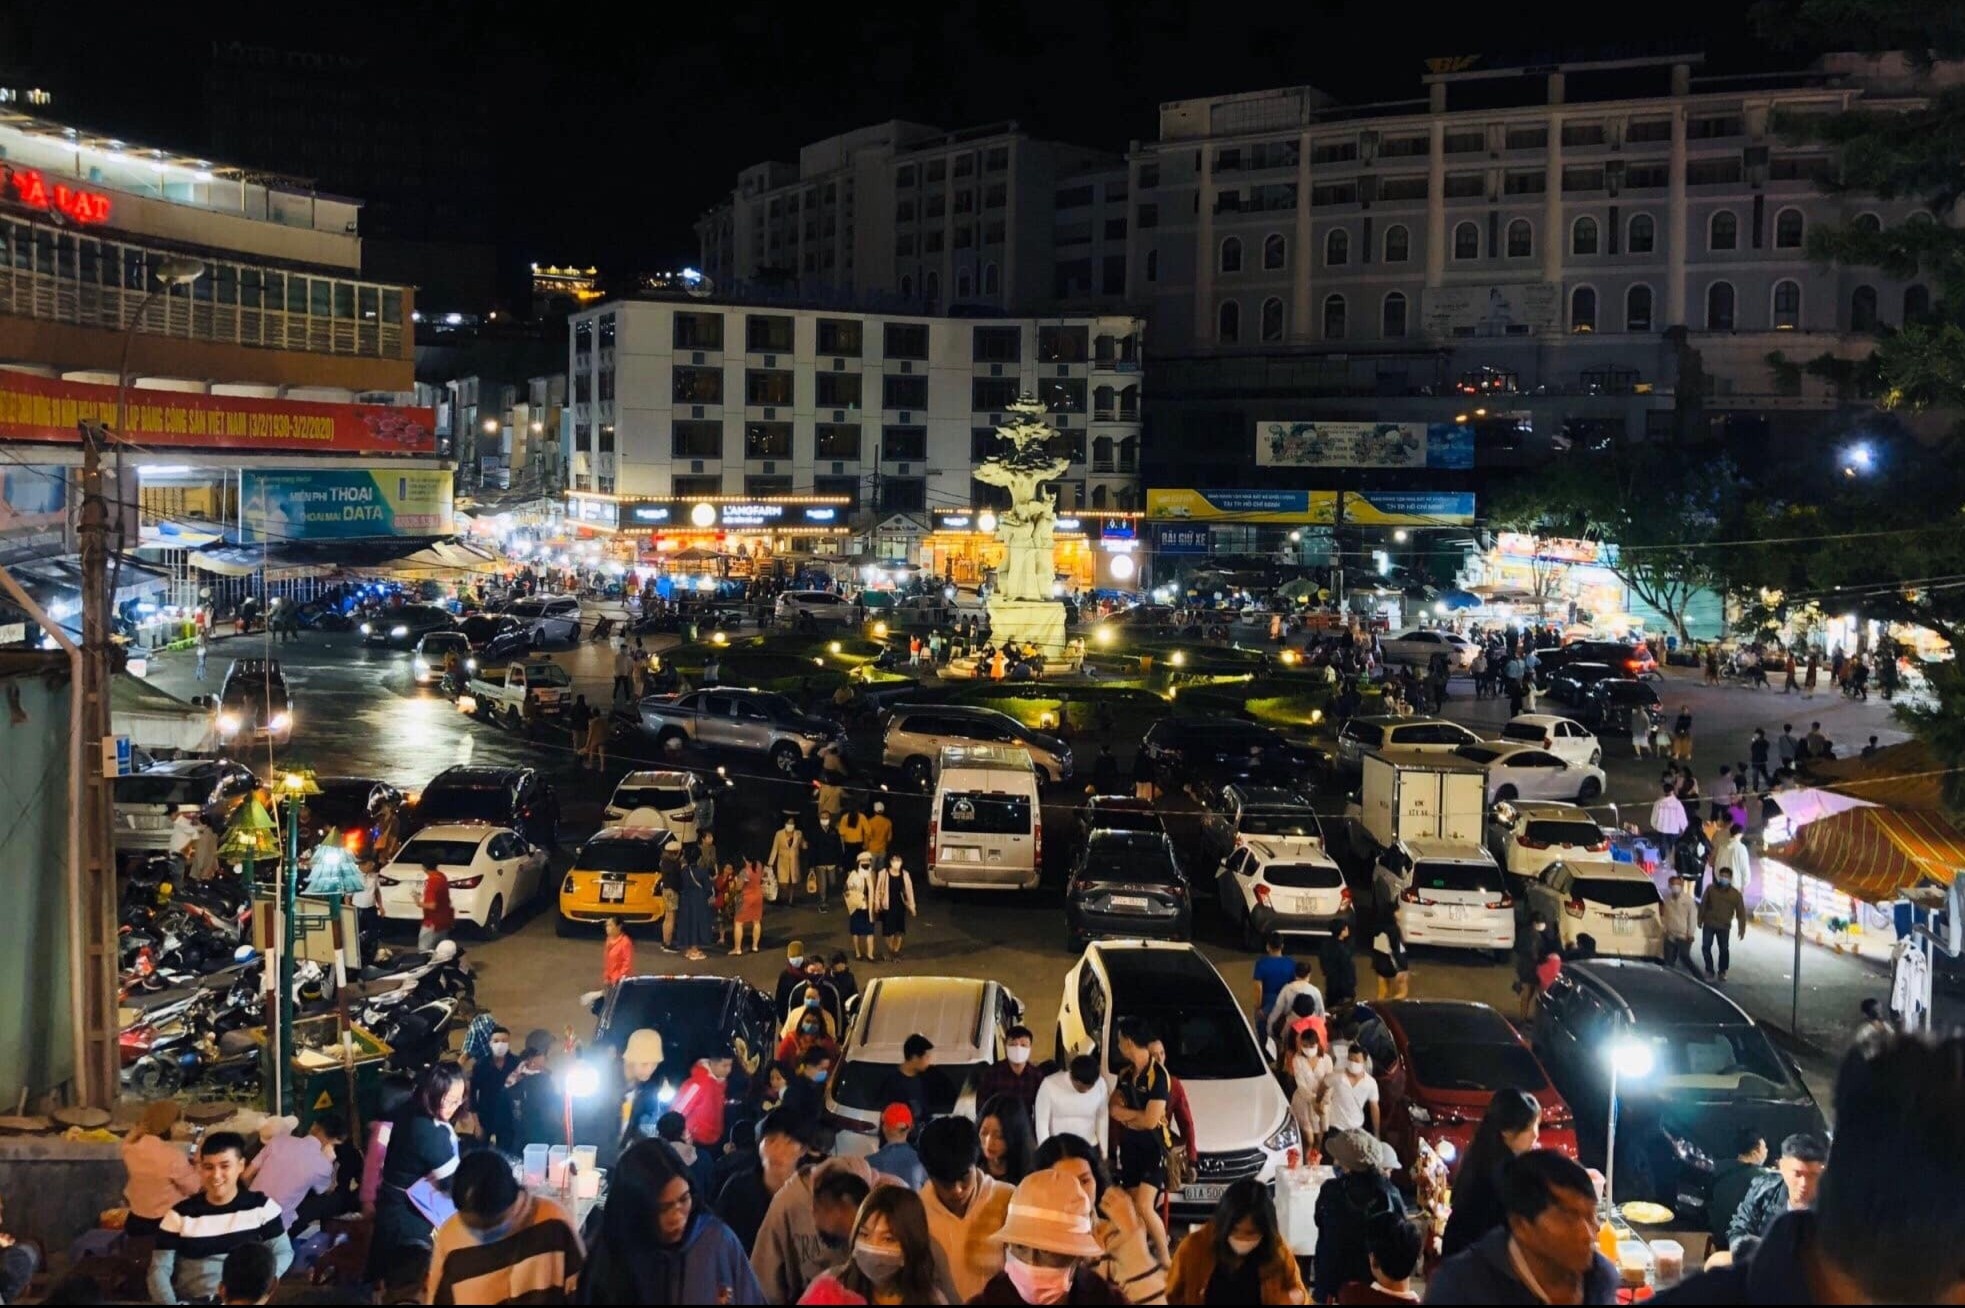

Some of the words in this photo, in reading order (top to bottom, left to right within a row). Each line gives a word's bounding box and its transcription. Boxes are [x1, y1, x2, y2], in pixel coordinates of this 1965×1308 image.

[227, 411, 247, 436] NAM
[329, 486, 373, 504] THOẠI
[343, 505, 384, 521] DATA
[1195, 533, 1206, 545] XE
